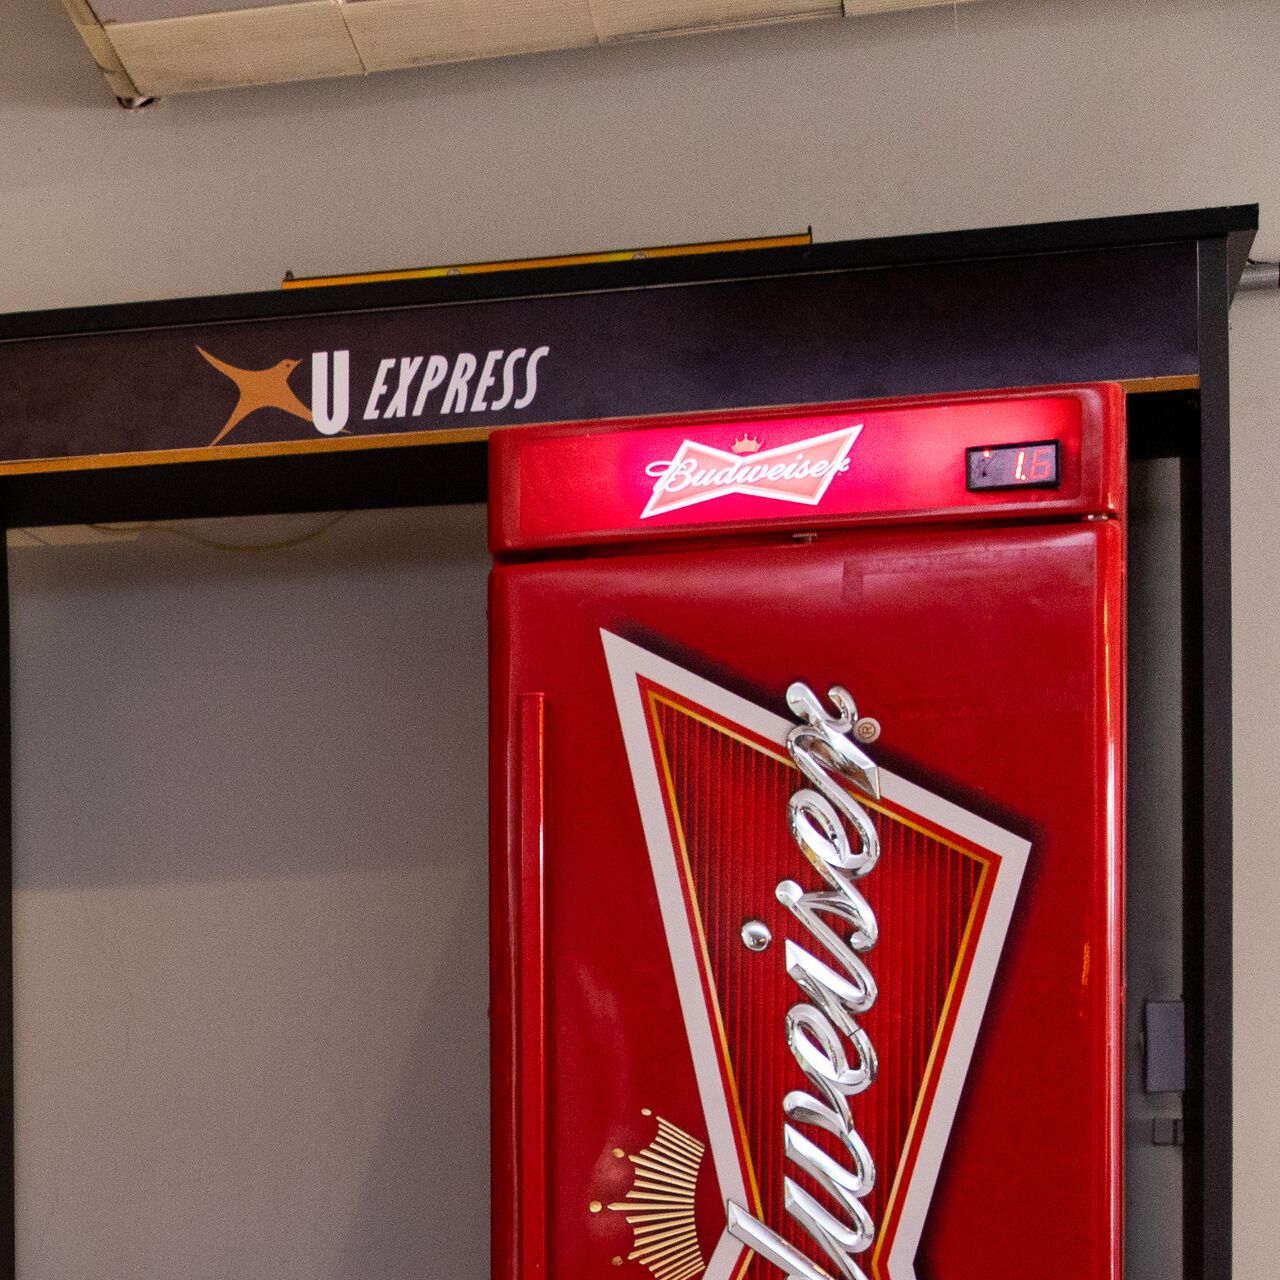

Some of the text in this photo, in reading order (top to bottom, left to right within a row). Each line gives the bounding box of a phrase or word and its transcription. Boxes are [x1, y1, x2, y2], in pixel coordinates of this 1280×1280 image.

[312, 346, 549, 435] U EXPRESS
[645, 453, 851, 493] Budweiser
